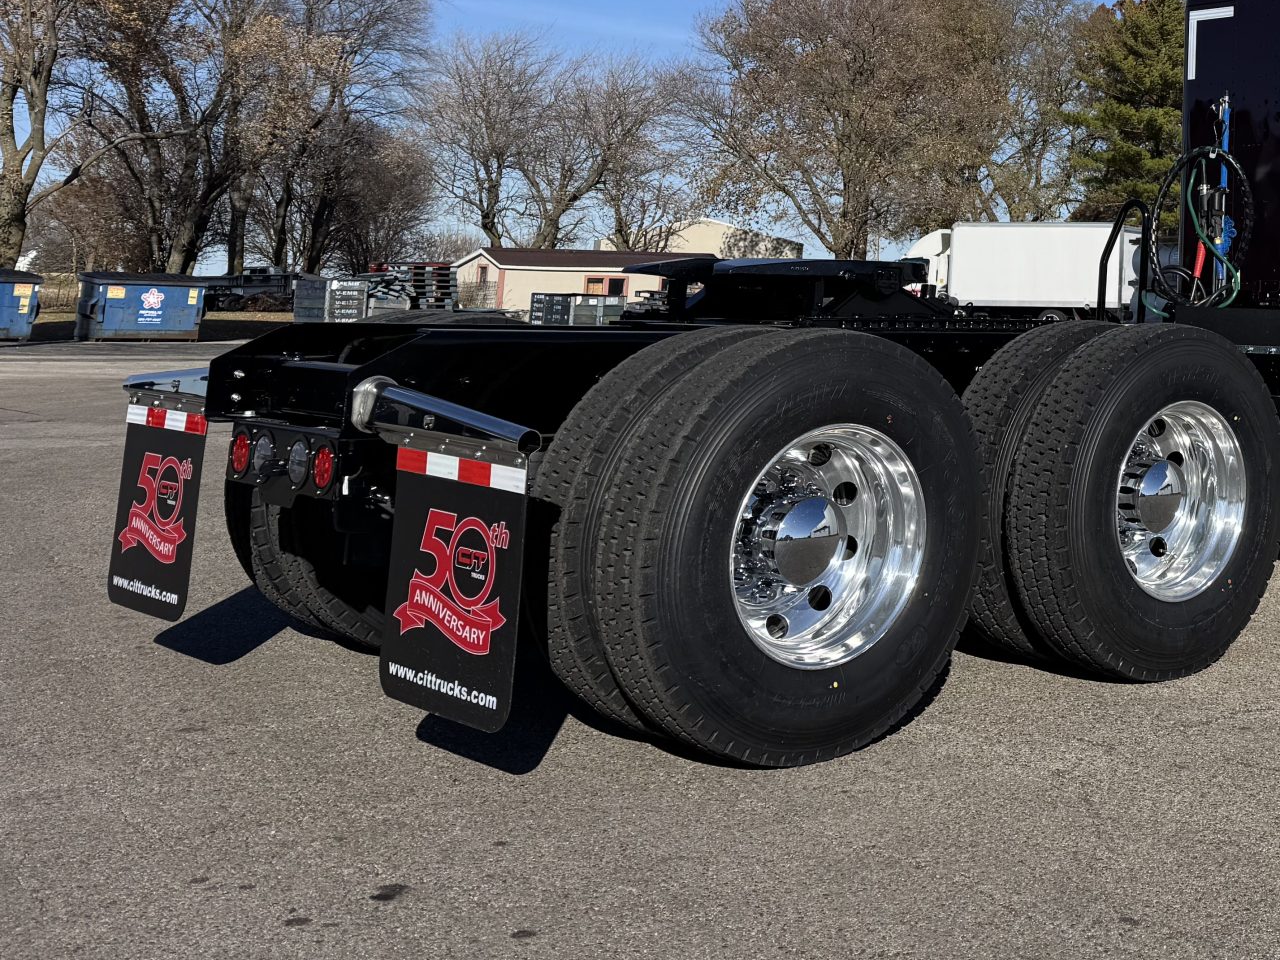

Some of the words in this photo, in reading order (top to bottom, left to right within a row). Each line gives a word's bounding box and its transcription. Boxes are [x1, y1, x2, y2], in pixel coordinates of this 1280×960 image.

[130, 516, 175, 556] ANNIVERSARY
[455, 546, 488, 572] CIT
[112, 574, 179, 605] www.cittrucks.com
[413, 589, 486, 646] ANNIVERSARY
[388, 661, 497, 710] www.cittrucks.com
